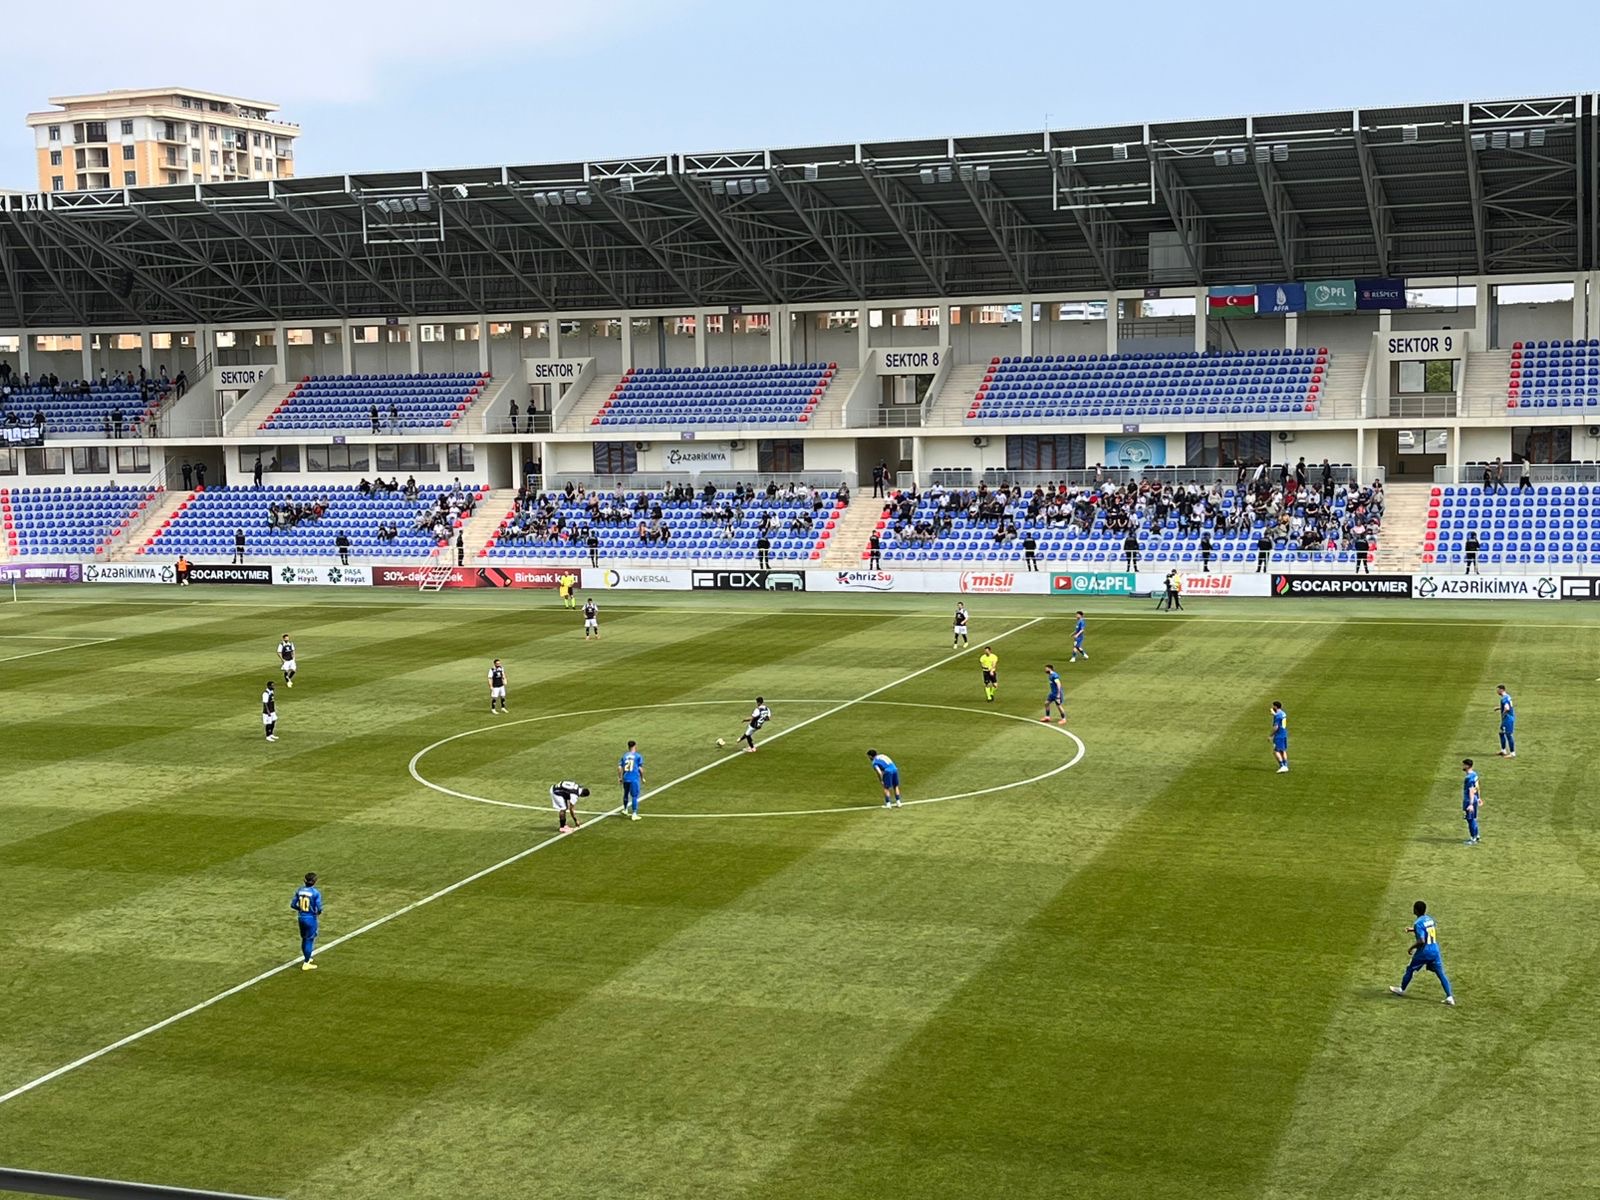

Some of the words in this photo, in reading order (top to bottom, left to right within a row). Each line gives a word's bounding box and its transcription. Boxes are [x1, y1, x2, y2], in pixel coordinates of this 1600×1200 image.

[1331, 288, 1346, 296] PFL
[1388, 337, 1439, 353] SEKTOR
[1444, 336, 1452, 351] 9
[885, 353, 928, 367] SEKTOR
[932, 352, 939, 366] 8
[535, 363, 573, 377] SEKTOR
[577, 363, 583, 374] 7
[221, 371, 256, 384] SEKTOR
[101, 566, 156, 579] AZƏRİKİMYA
[190, 570, 223, 580] SOCAR
[223, 570, 270, 580] POLYMER
[515, 572, 553, 582] Birbank
[623, 575, 671, 583] UNIVERSAL
[972, 571, 1014, 586] misli
[1074, 574, 1132, 591] @AzPFL
[1186, 574, 1232, 589] misli
[1292, 580, 1340, 592] SOCAR
[1342, 580, 1408, 592] POLYMER
[1441, 577, 1528, 594] AZƏRİKİMYA
[299, 896, 310, 912] 10
